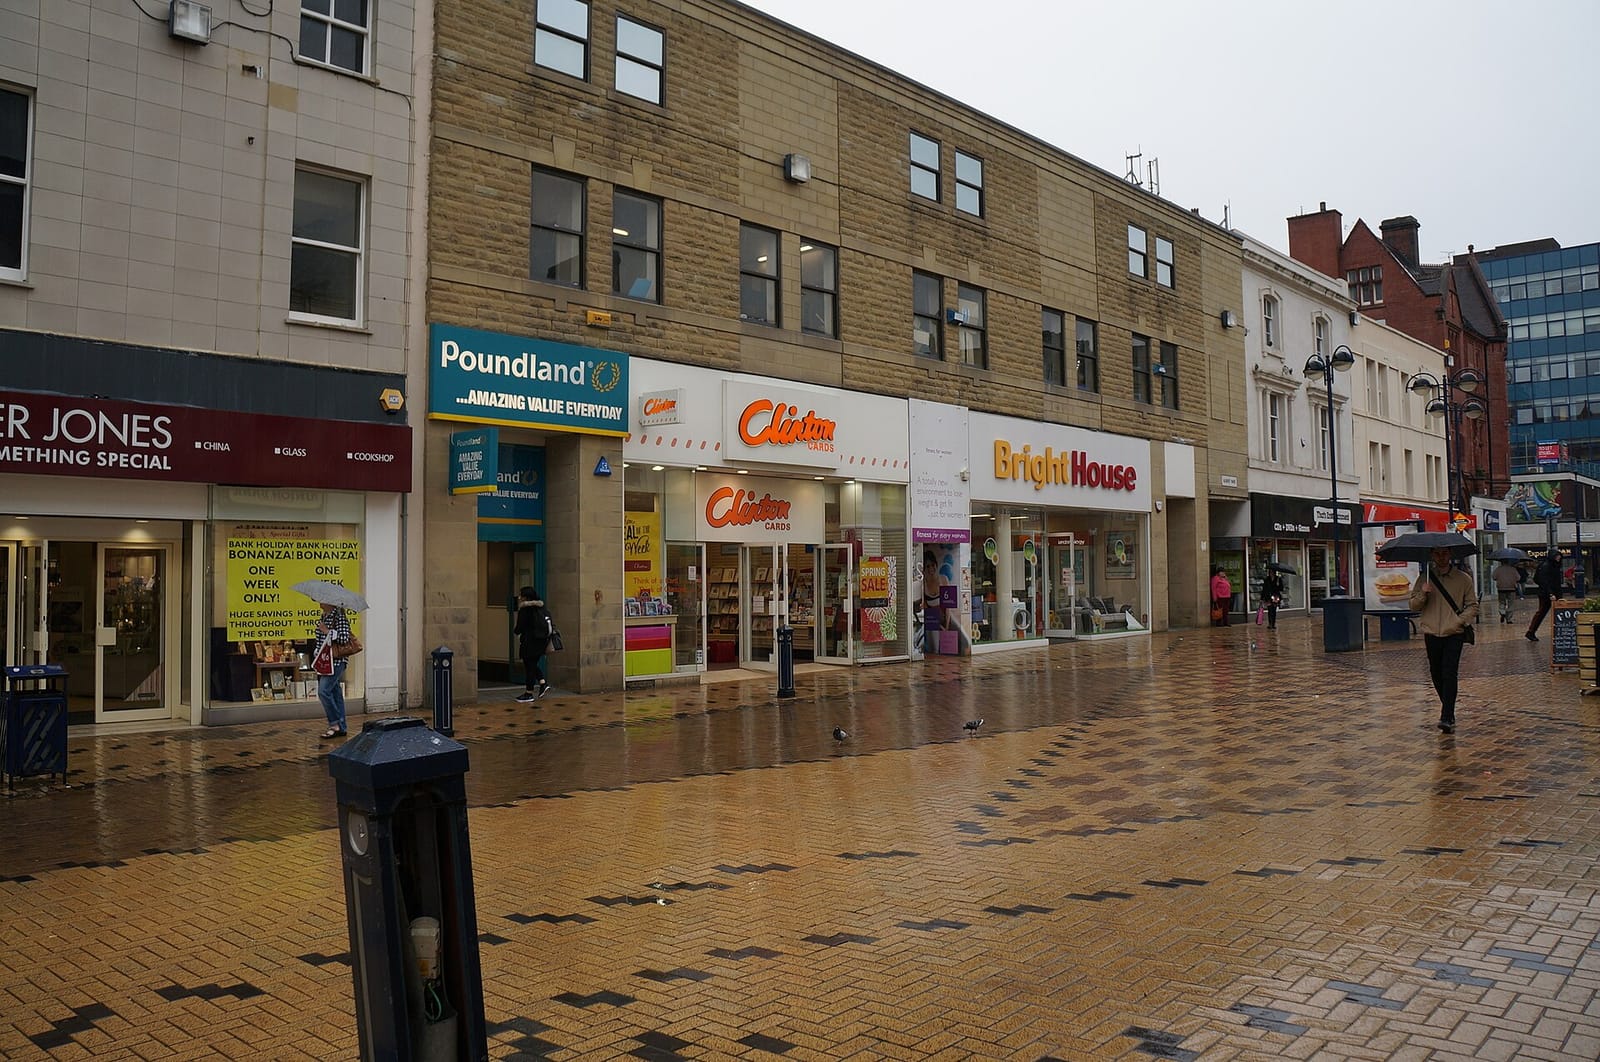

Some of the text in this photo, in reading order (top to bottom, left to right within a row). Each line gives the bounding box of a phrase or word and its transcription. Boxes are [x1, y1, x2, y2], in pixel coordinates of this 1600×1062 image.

[441, 340, 585, 386] Poundland
[527, 396, 563, 414] VALUE
[566, 401, 622, 420] EVERYDAY
[0, 403, 173, 449] R JONES
[737, 398, 836, 447] Clinton
[203, 441, 230, 452] CHINA
[807, 442, 834, 453] CARDS
[282, 447, 307, 457] GLASS
[458, 451, 483, 463] AMAZING
[96, 451, 172, 470] SPECIAL
[354, 452, 394, 463] COOKSHOP
[462, 461, 479, 472] VALUE
[457, 470, 483, 482] EVERYDAY
[510, 490, 539, 499] EVERYDAY
[705, 486, 791, 529] Clinton
[764, 521, 791, 531] CARDS
[229, 541, 294, 549] BANK HOLIDAY
[322, 542, 358, 550] HOLIDAY
[229, 550, 294, 560] BONANZA!
[296, 551, 358, 560] BONANZA!
[248, 566, 275, 575] ONE
[315, 566, 340, 575] ONE
[861, 567, 886, 577] SPRING
[244, 579, 279, 589] WEEK
[861, 578, 886, 592] SALE
[243, 594, 280, 604] ONLY!
[229, 610, 293, 619] HUGE SAVINGS
[297, 609, 321, 617] HUGE
[230, 619, 293, 629] THROUGHOUT
[239, 629, 285, 638] THE STORE
